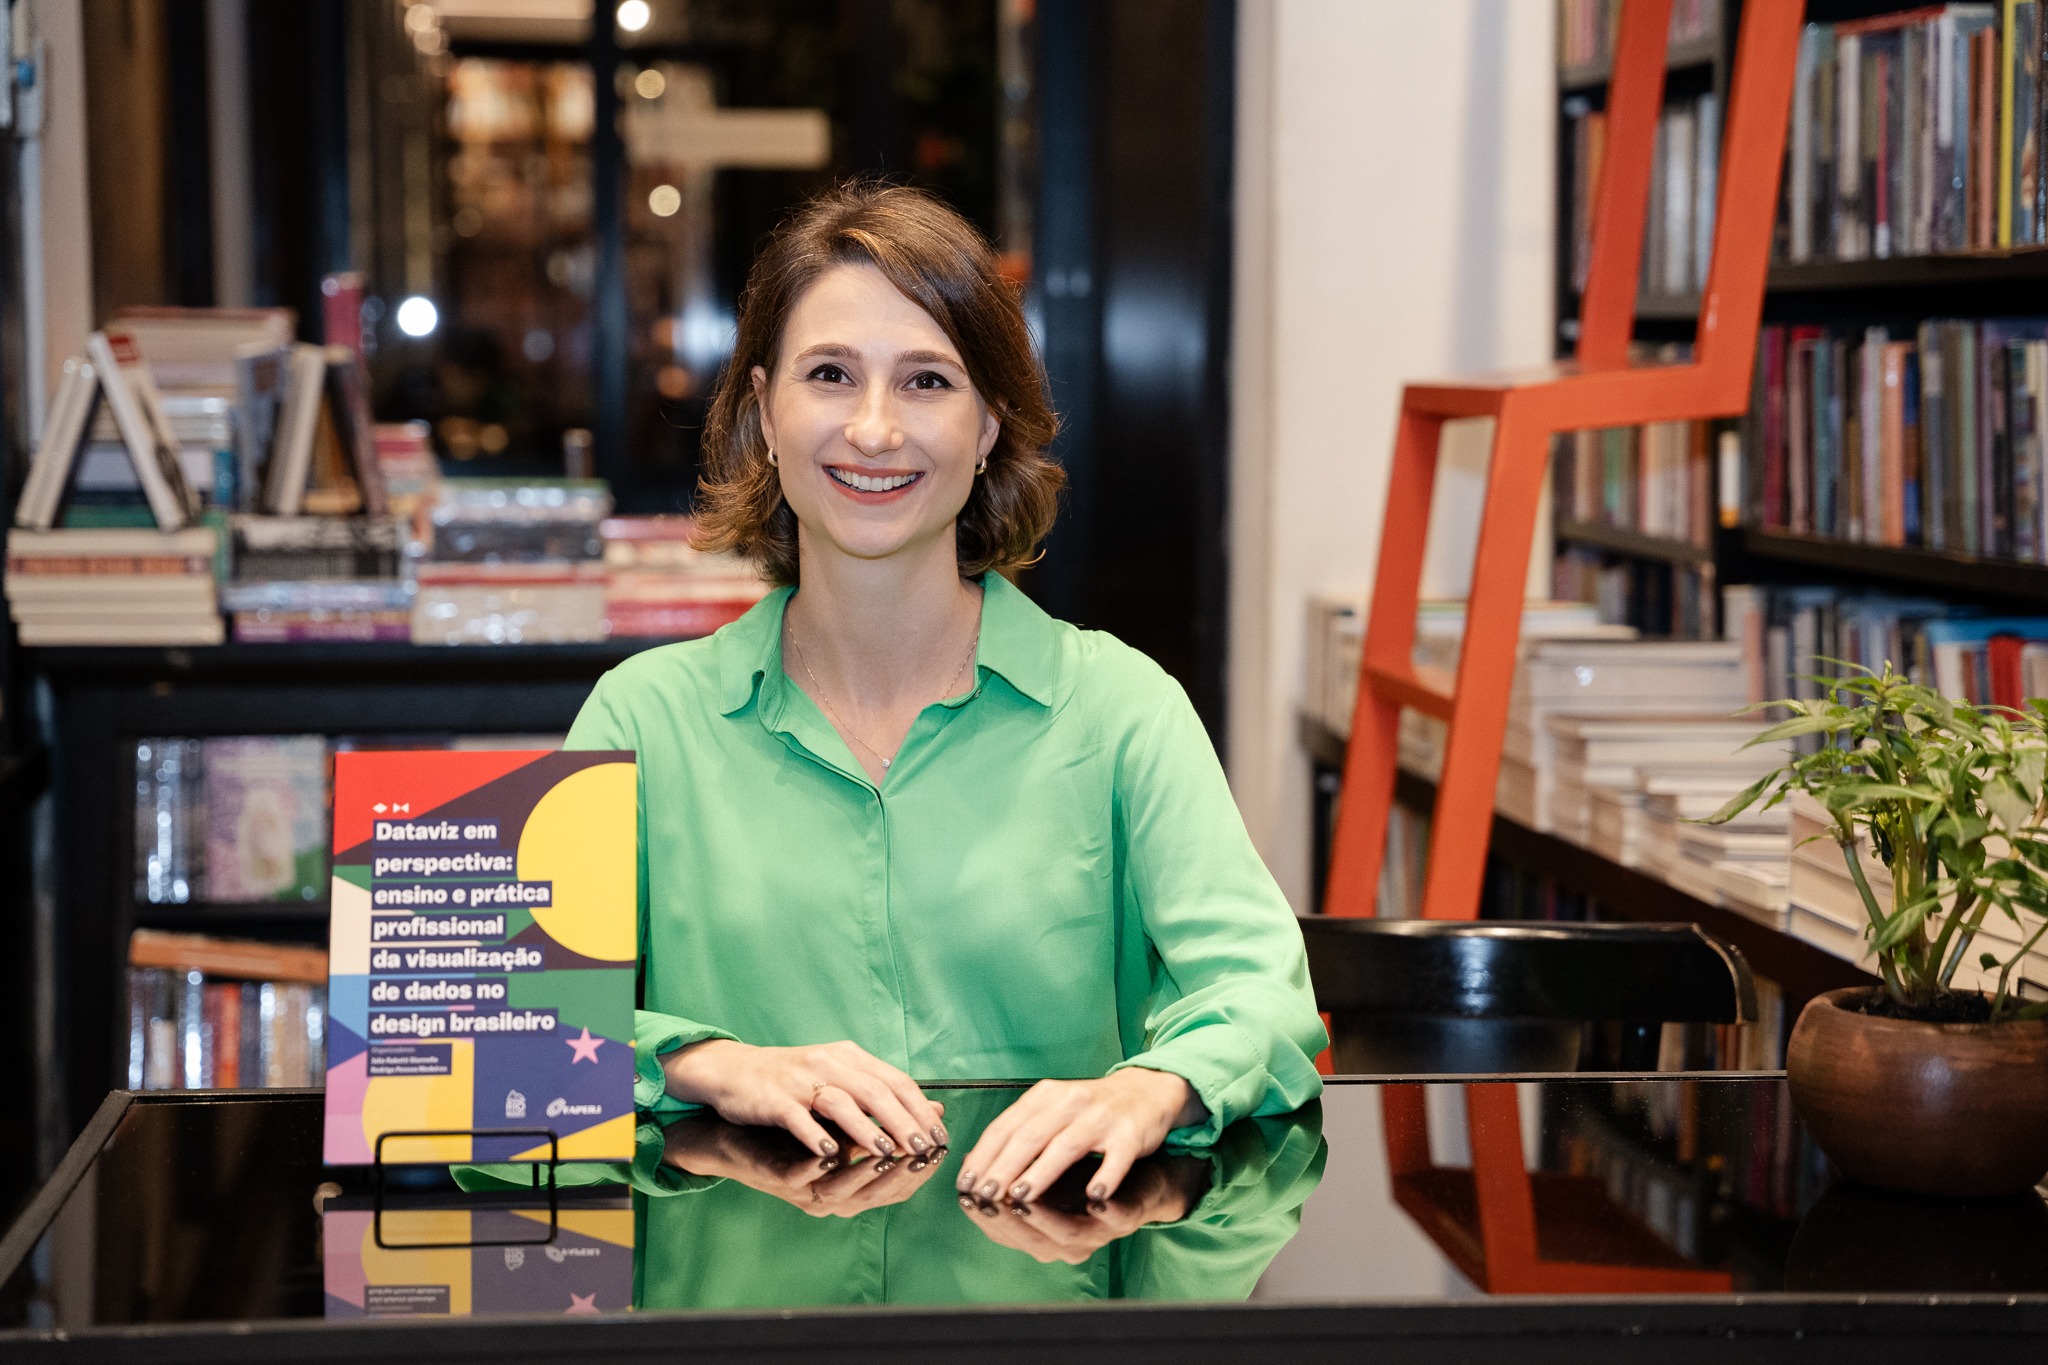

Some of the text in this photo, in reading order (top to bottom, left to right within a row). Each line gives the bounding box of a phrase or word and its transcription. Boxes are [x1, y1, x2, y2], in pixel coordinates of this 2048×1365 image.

[375, 821, 498, 841] Dataviz em
[375, 852, 513, 877] perspectiva:
[374, 883, 550, 908] ensino e prática
[373, 915, 504, 941] profissional
[372, 947, 542, 972] da visualização
[371, 980, 505, 1002] de dados no
[370, 1011, 556, 1038] design brasileiro
